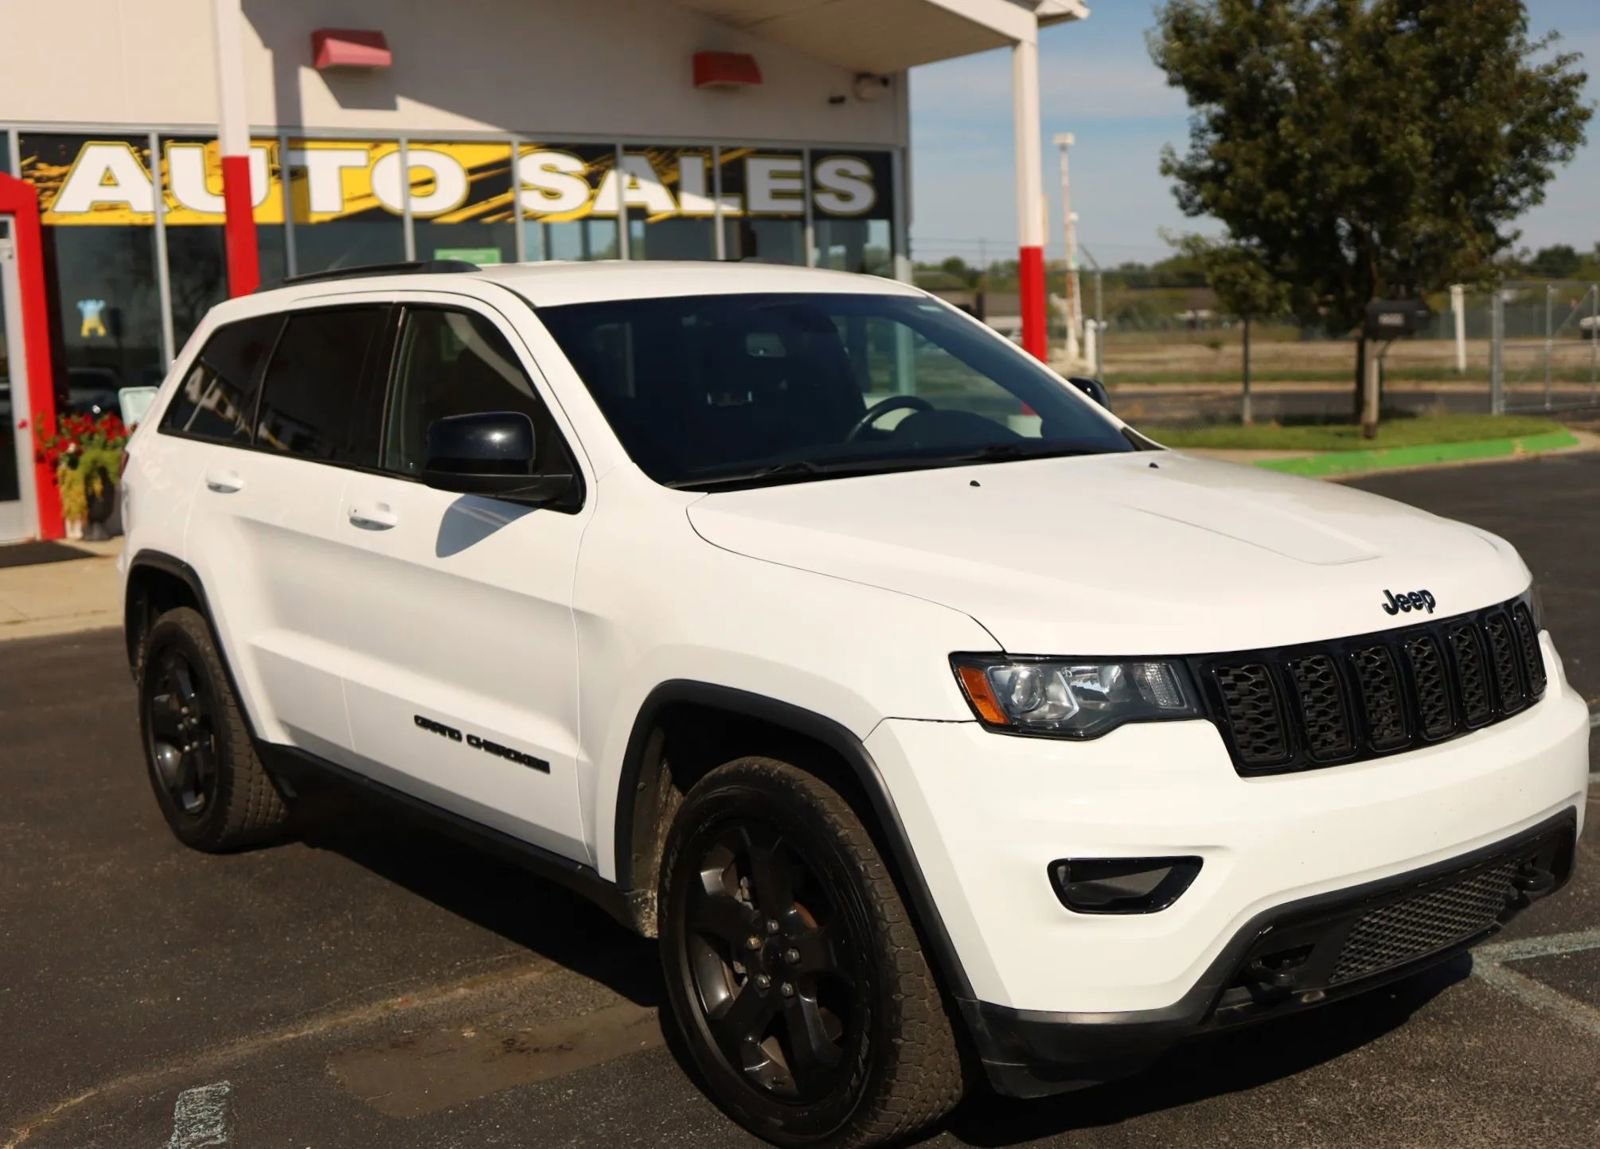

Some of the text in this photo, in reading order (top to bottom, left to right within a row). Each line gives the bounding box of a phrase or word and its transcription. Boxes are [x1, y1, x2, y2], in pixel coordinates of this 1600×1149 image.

[51, 141, 876, 217] AUTO SALES
[1382, 589, 1436, 615] Jeep
[414, 714, 463, 743] GRAND
